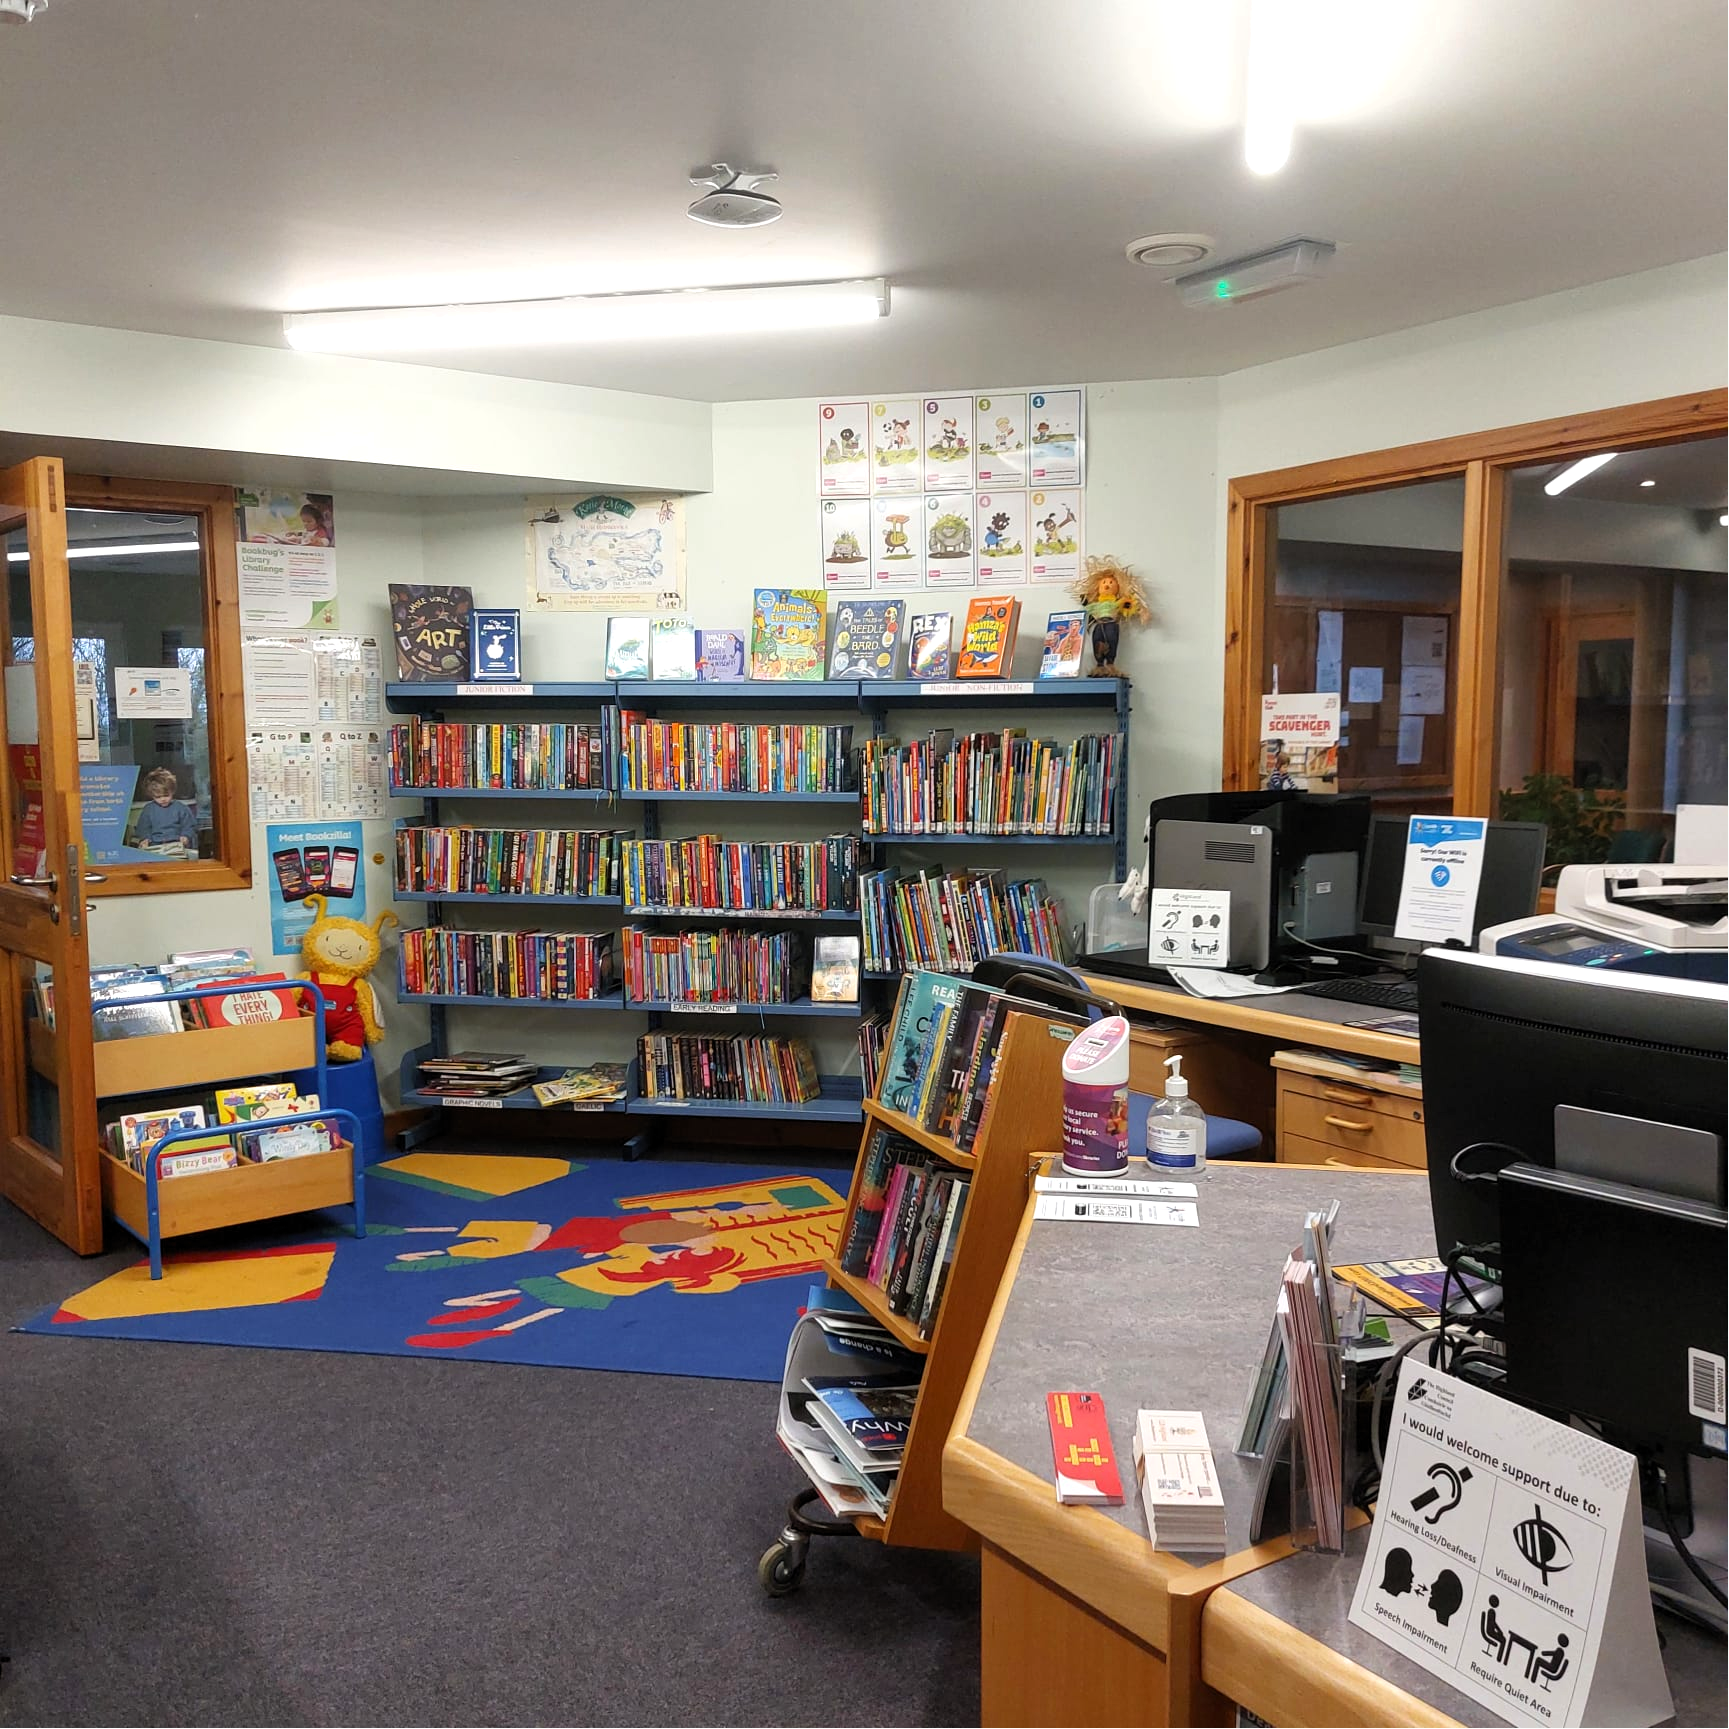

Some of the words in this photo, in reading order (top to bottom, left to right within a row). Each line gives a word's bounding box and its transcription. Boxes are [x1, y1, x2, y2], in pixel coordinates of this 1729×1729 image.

[241, 547, 285, 557] Bookbug's
[242, 556, 270, 565] Library
[242, 564, 284, 574] Challenge
[773, 602, 812, 613] Animals
[770, 614, 815, 623] Everywhere!
[654, 618, 688, 635] TOTO
[850, 624, 885, 634] BEEDLE
[912, 615, 951, 634] REX
[967, 620, 1006, 633] Hamza's
[415, 628, 462, 650] ART
[972, 631, 997, 643] Wild
[707, 641, 726, 649] DAHL
[851, 641, 879, 650] BARD
[966, 640, 998, 652] World
[930, 684, 960, 692] JUNIOR
[966, 684, 1023, 692] NON-FICTION
[1269, 720, 1331, 731] SCAVENGER
[340, 733, 346, 741] Q
[279, 833, 304, 842] Meet
[305, 831, 352, 841] Bookzilla!
[1420, 847, 1437, 855] Sorry!
[240, 993, 264, 1001] HATE
[931, 985, 956, 1000] REA
[233, 1001, 268, 1014] EVERY
[673, 1003, 697, 1011] EARLY
[237, 1012, 272, 1024] THING!
[947, 1006, 960, 1042] FAMILY
[968, 1032, 987, 1088] Jardine
[444, 1099, 473, 1107] GRAPHIC
[1075, 1110, 1098, 1118] secure
[1068, 1115, 1081, 1125] local
[1072, 1125, 1099, 1136] service.
[1071, 1138, 1086, 1147] you.
[175, 1158, 200, 1169] Bizzy
[201, 1155, 221, 1166] Bear
[846, 1219, 860, 1257] HOLLY
[839, 1337, 874, 1351] change
[1436, 1385, 1455, 1397] Highland
[1437, 1393, 1453, 1404] Council
[851, 1419, 910, 1434] Why
[1402, 1412, 1407, 1424] I
[1409, 1417, 1444, 1441] would
[1446, 1434, 1499, 1469] welcome
[1501, 1462, 1551, 1494] support
[1554, 1481, 1579, 1507] due
[1582, 1499, 1601, 1517] to:
[1391, 1510, 1419, 1534] Hearing
[1421, 1526, 1477, 1564] Loss/Deafness
[1495, 1566, 1521, 1587] Visual
[1522, 1581, 1574, 1617] Impairment
[1374, 1602, 1401, 1626] Speech
[1402, 1617, 1448, 1654] Impairment
[1470, 1661, 1504, 1688] Require
[1504, 1681, 1529, 1704] Quiet
[1530, 1697, 1551, 1719] Area
